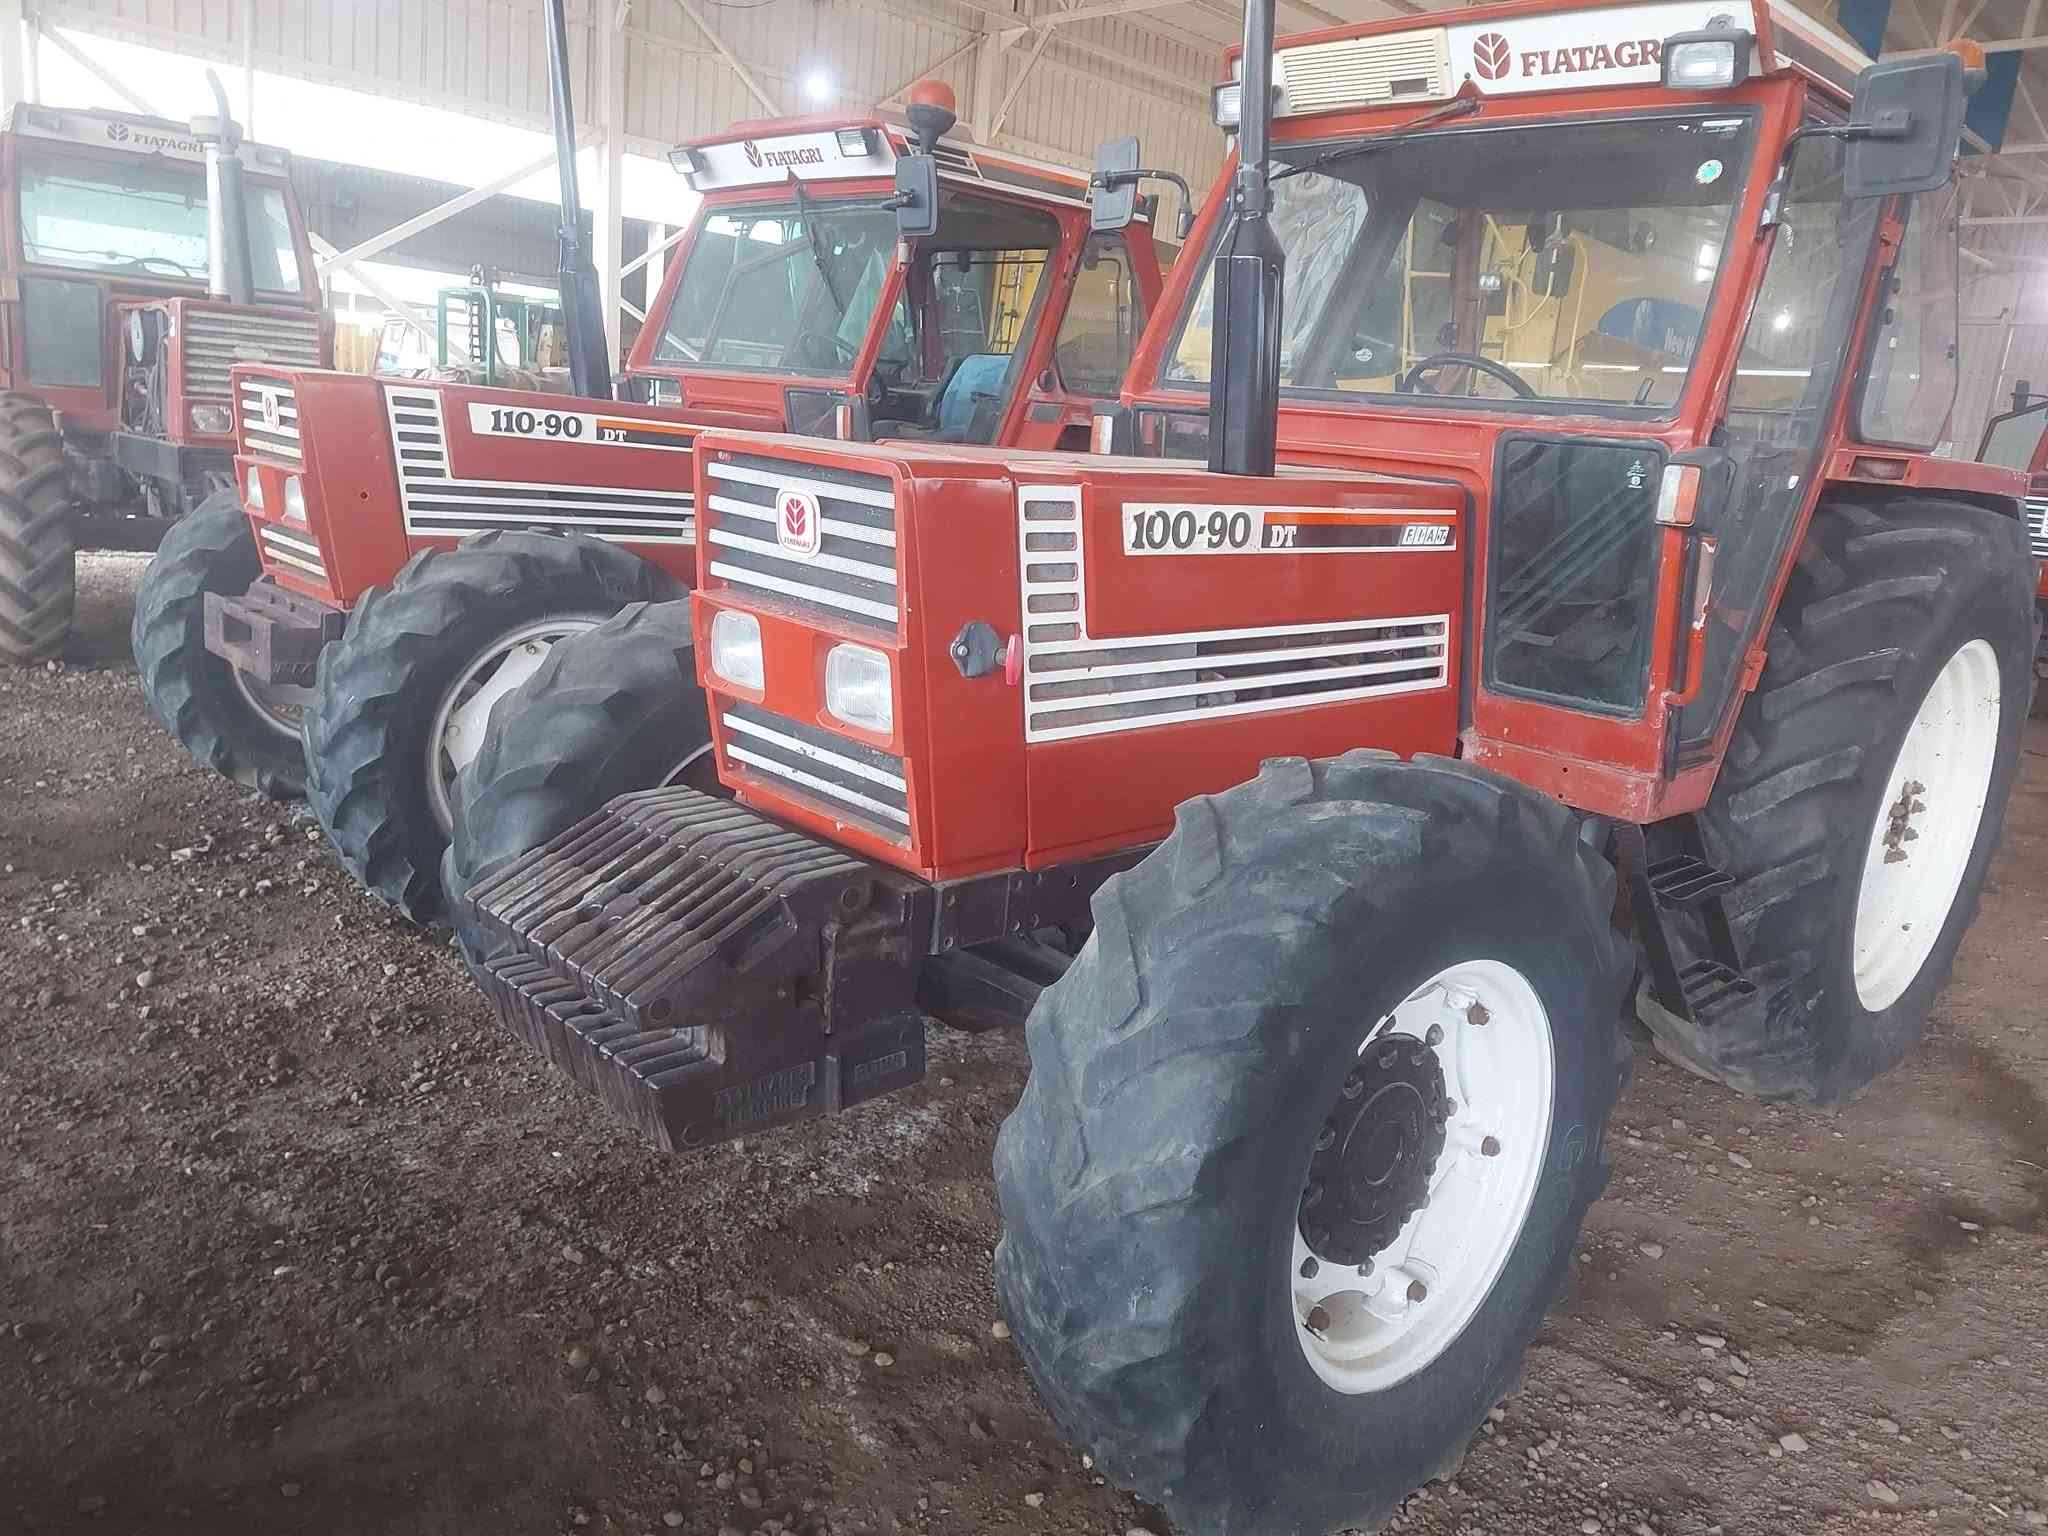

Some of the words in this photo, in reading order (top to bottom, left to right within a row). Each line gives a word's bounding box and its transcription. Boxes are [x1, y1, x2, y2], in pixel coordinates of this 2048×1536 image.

[1520, 39, 1664, 77] FIATAGR
[133, 132, 204, 153] FIATAGRI
[763, 147, 824, 167] FIATAGRI
[491, 409, 582, 438] 110-90
[603, 428, 627, 442] DT
[1131, 510, 1251, 549] 100-90
[1270, 525, 1297, 547] DT
[1404, 526, 1448, 544] FIAT
